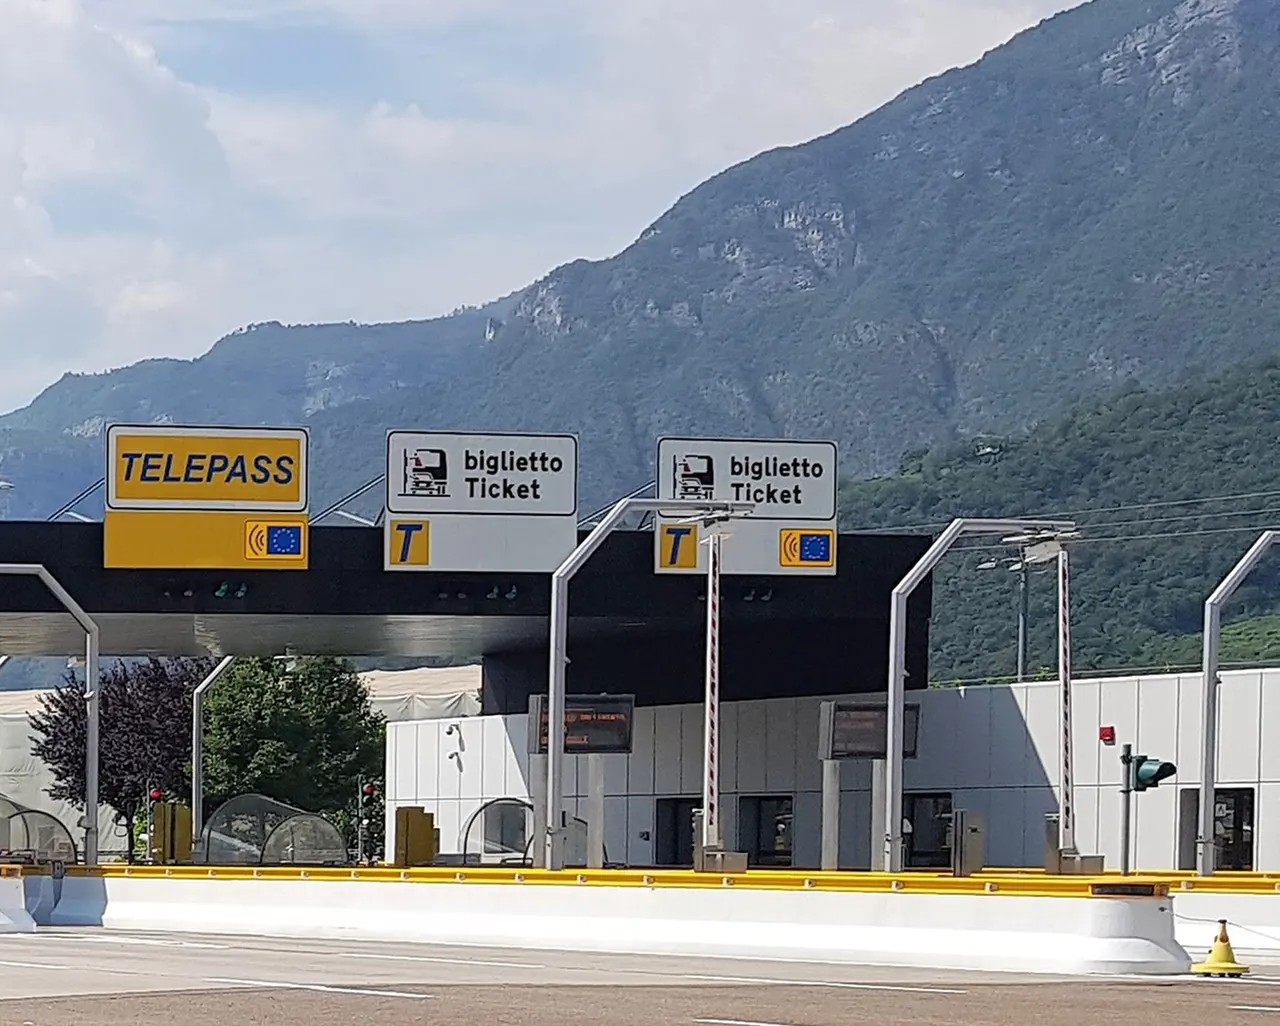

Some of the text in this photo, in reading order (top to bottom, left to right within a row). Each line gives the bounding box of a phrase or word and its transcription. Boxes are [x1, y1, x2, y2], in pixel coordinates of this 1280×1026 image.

[122, 453, 294, 484] TELEPASS
[464, 450, 563, 475] biglietto
[730, 456, 823, 480] biglietto
[465, 478, 541, 499] Ticket
[731, 483, 802, 504] Ticket
[395, 524, 423, 562] T
[666, 527, 692, 565] T
